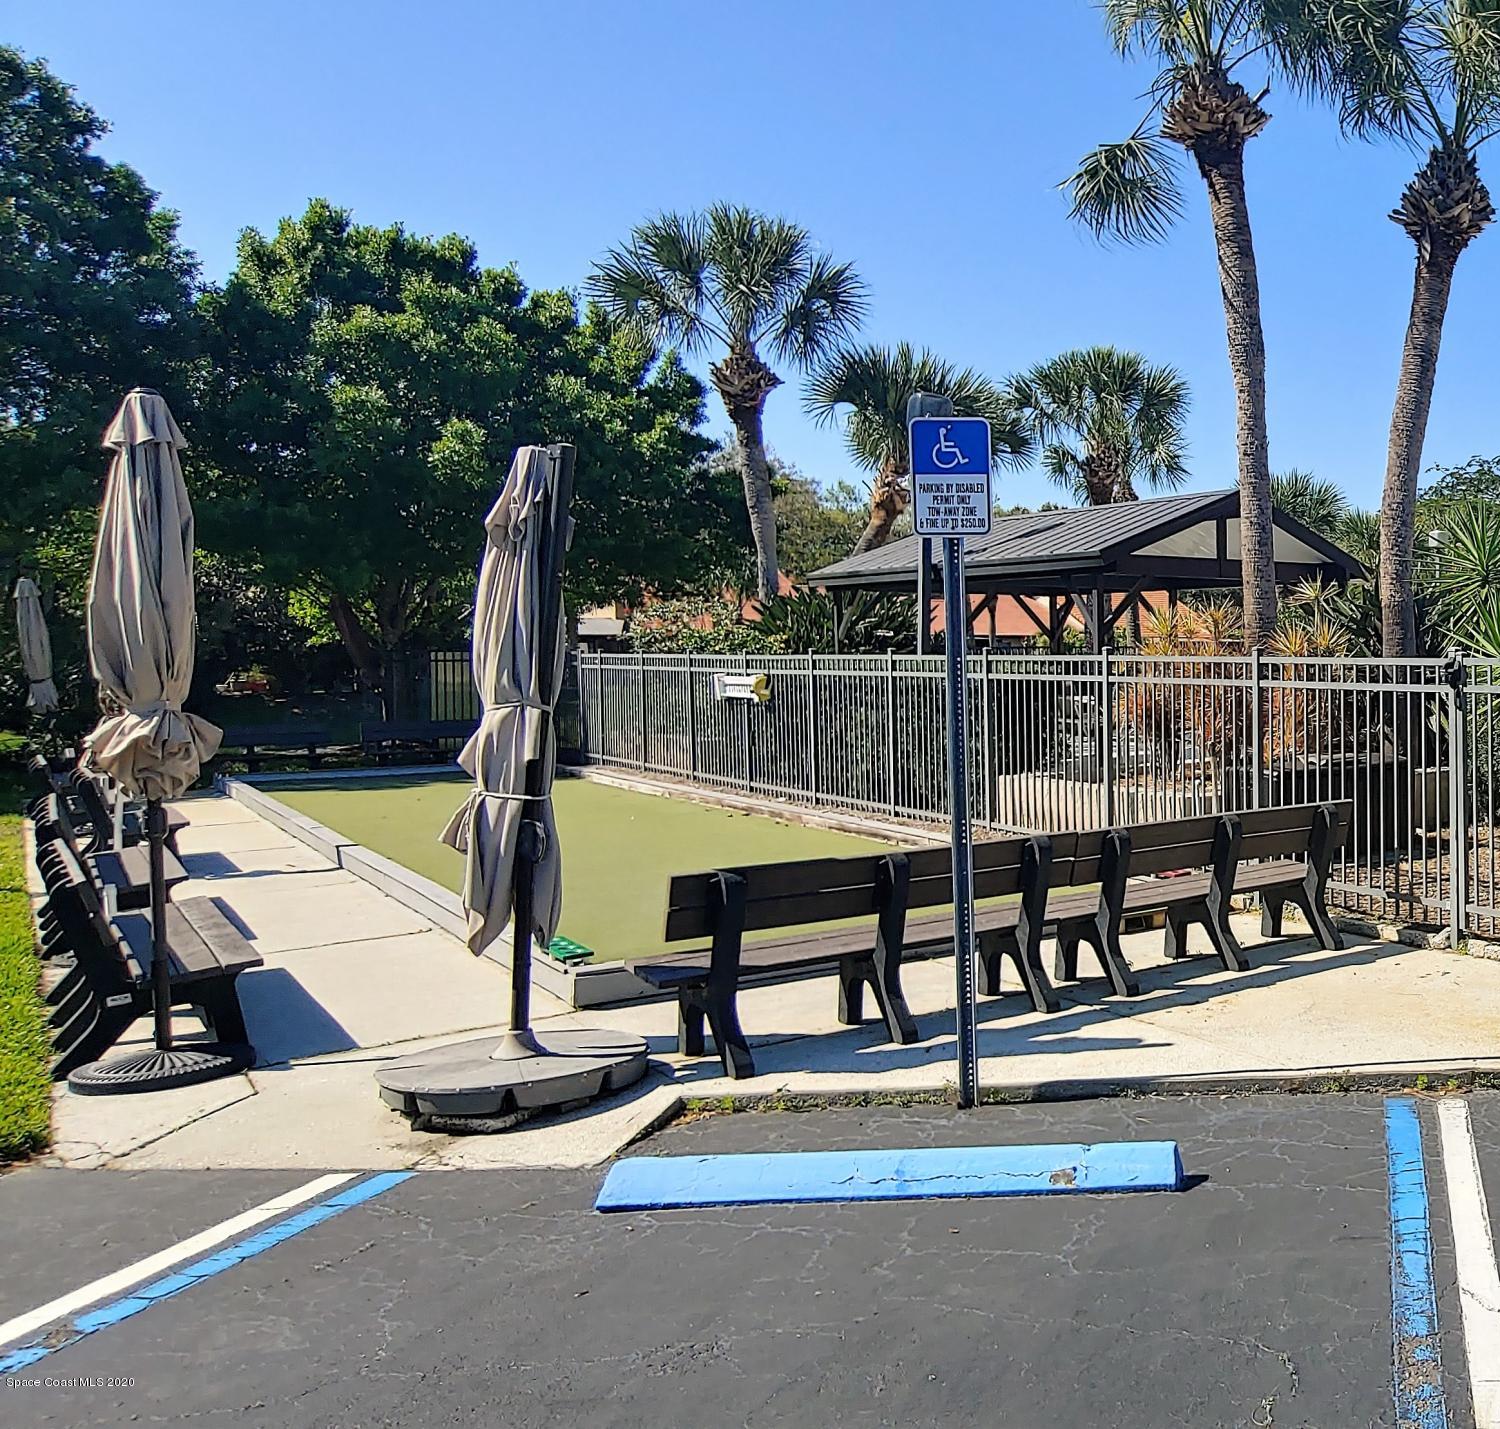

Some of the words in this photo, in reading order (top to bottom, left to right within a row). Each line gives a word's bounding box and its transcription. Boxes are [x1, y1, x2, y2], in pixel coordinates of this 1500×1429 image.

[919, 483, 944, 494] PARKING
[946, 483, 953, 494] BY
[956, 483, 984, 493] DISABLED
[932, 495, 954, 505] PERMIT
[957, 495, 971, 504] ONLY
[927, 507, 960, 516] TOW-AWAY
[962, 507, 977, 516] ZONE
[926, 518, 939, 528] FINE
[941, 518, 949, 528] UP
[951, 518, 958, 528] TO
[961, 518, 985, 528] $250.00
